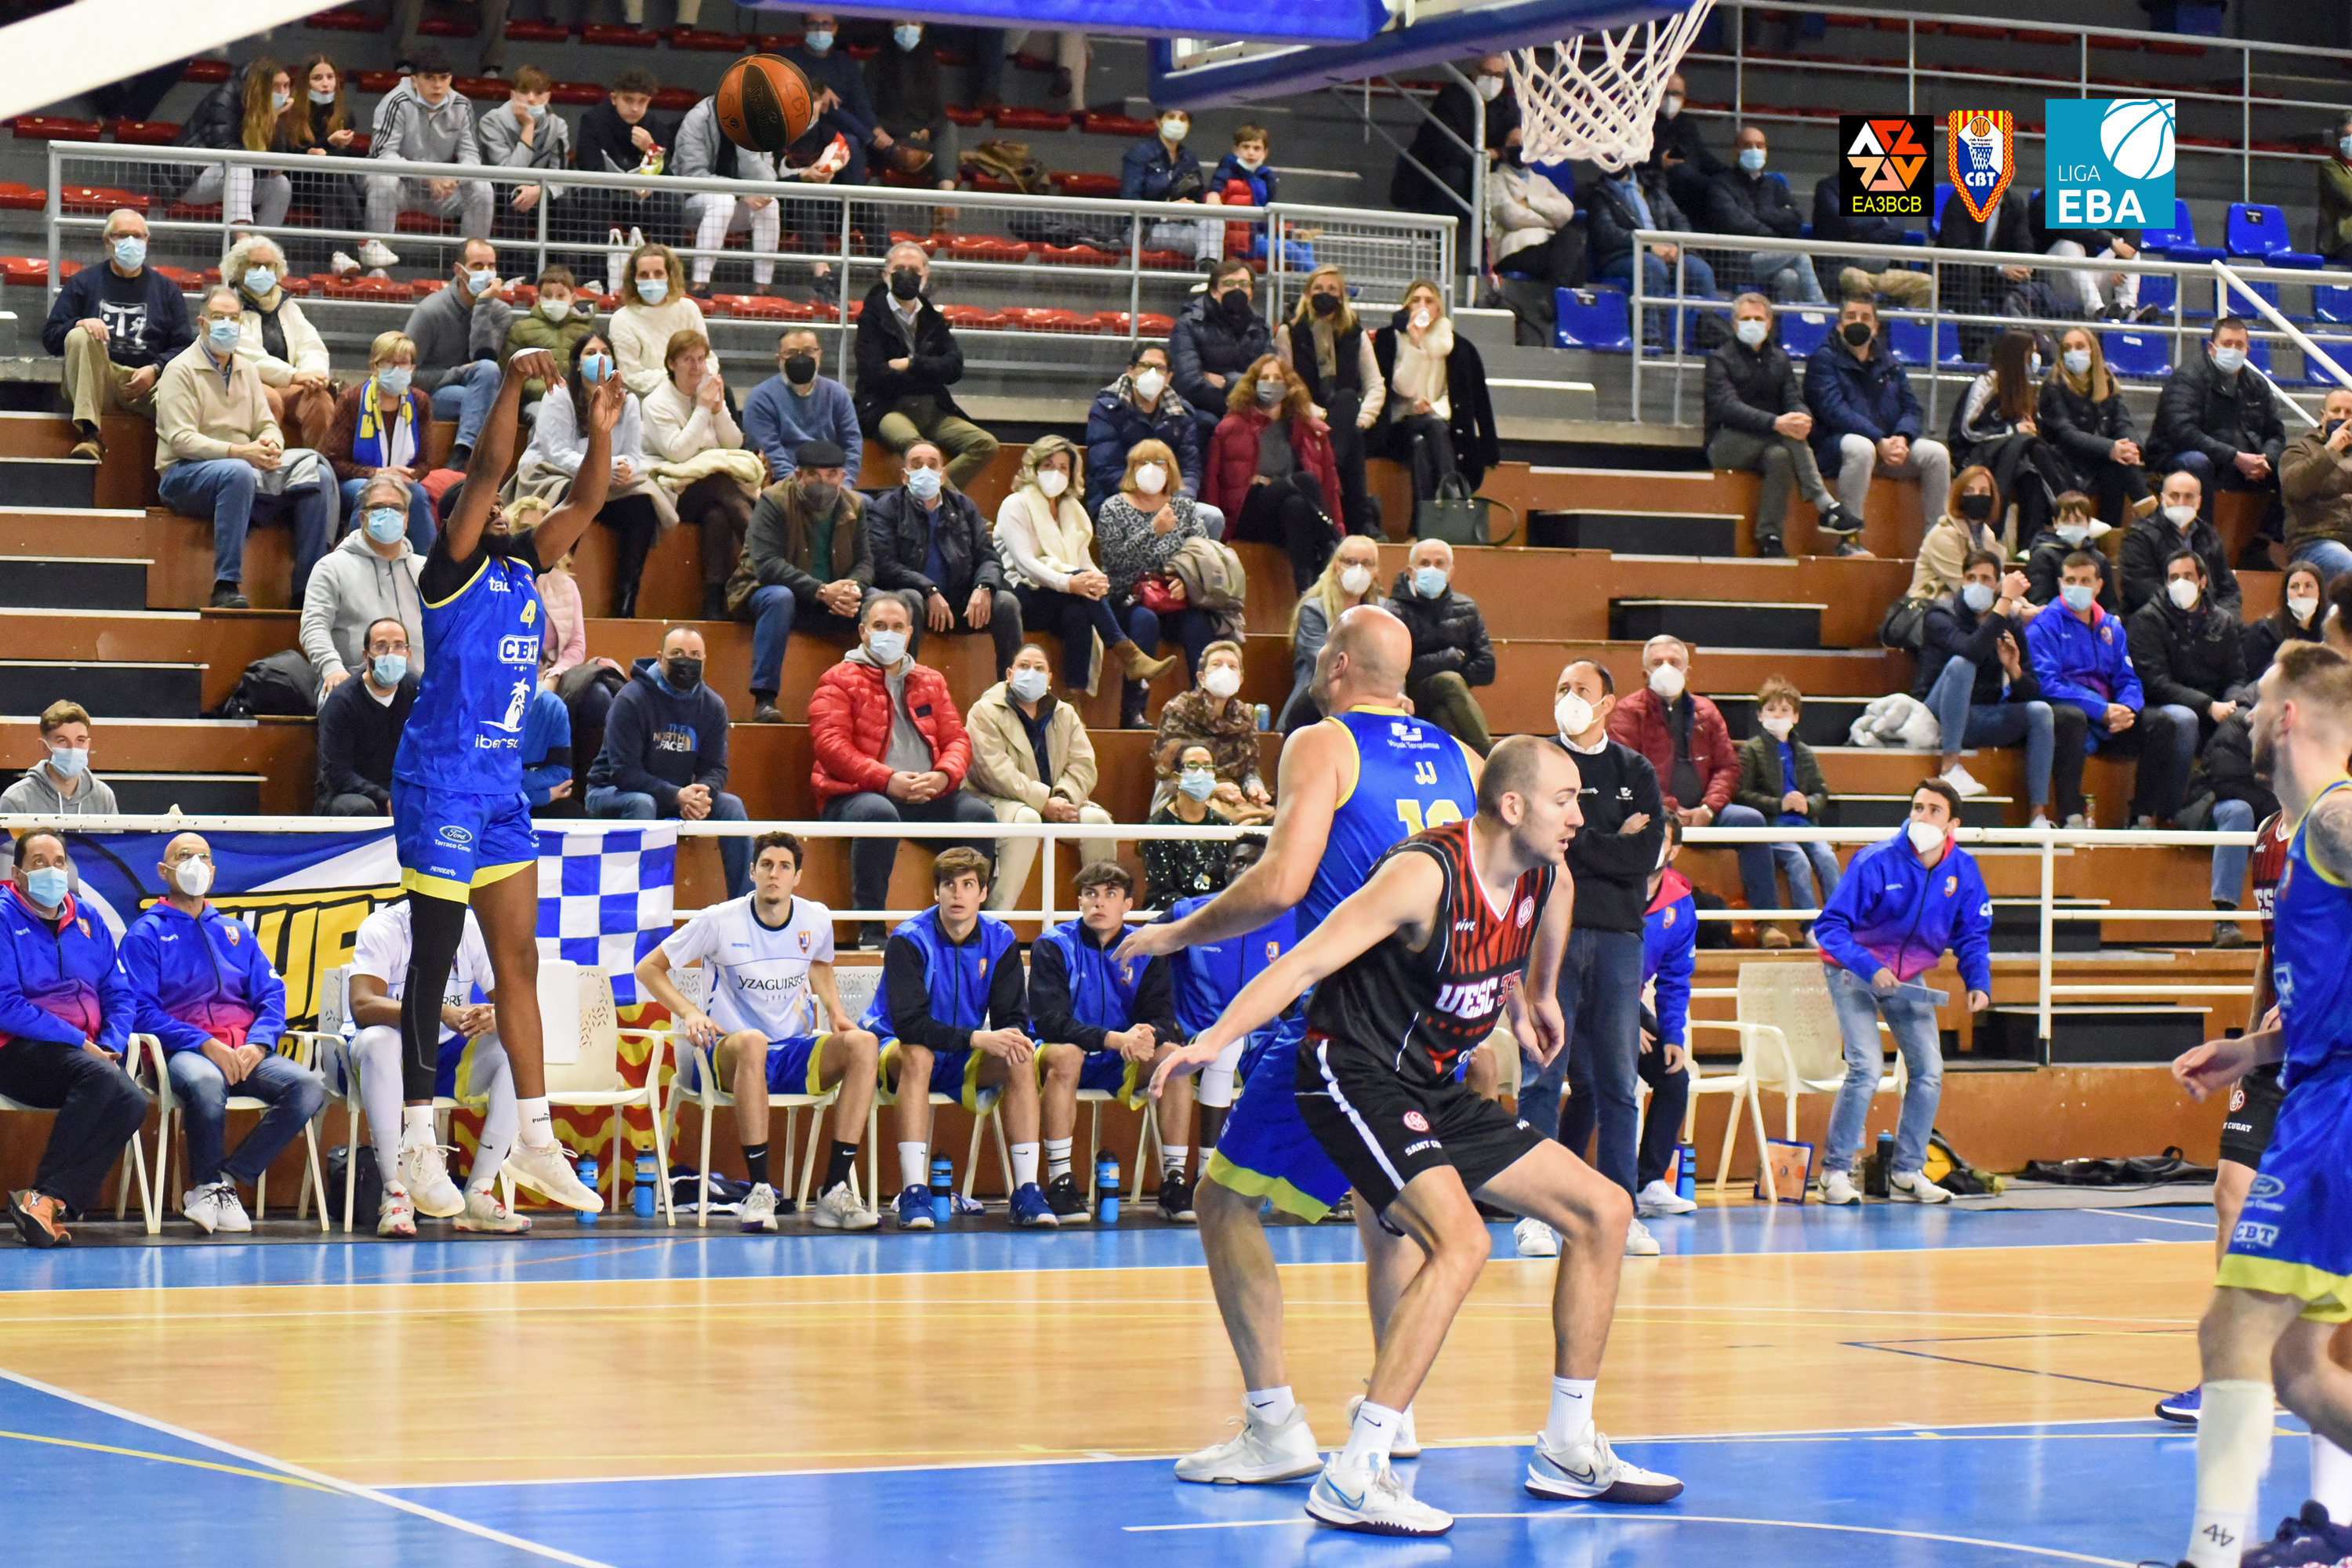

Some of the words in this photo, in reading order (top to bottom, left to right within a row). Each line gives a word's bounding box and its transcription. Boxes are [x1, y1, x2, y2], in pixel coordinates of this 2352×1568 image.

[746, 85, 777, 148] SPALDING
[520, 599, 537, 629] 4
[670, 724, 687, 733] THE
[652, 731, 686, 742] NORTH
[659, 741, 685, 753] FACE
[447, 828, 466, 840] Ford
[434, 839, 457, 849] Tarraco
[1435, 977, 1499, 1019] UESC
[2227, 1122, 2252, 1133] CUGAT
[1405, 1142, 1430, 1156] SANT
[2234, 1223, 2277, 1247] CBT
